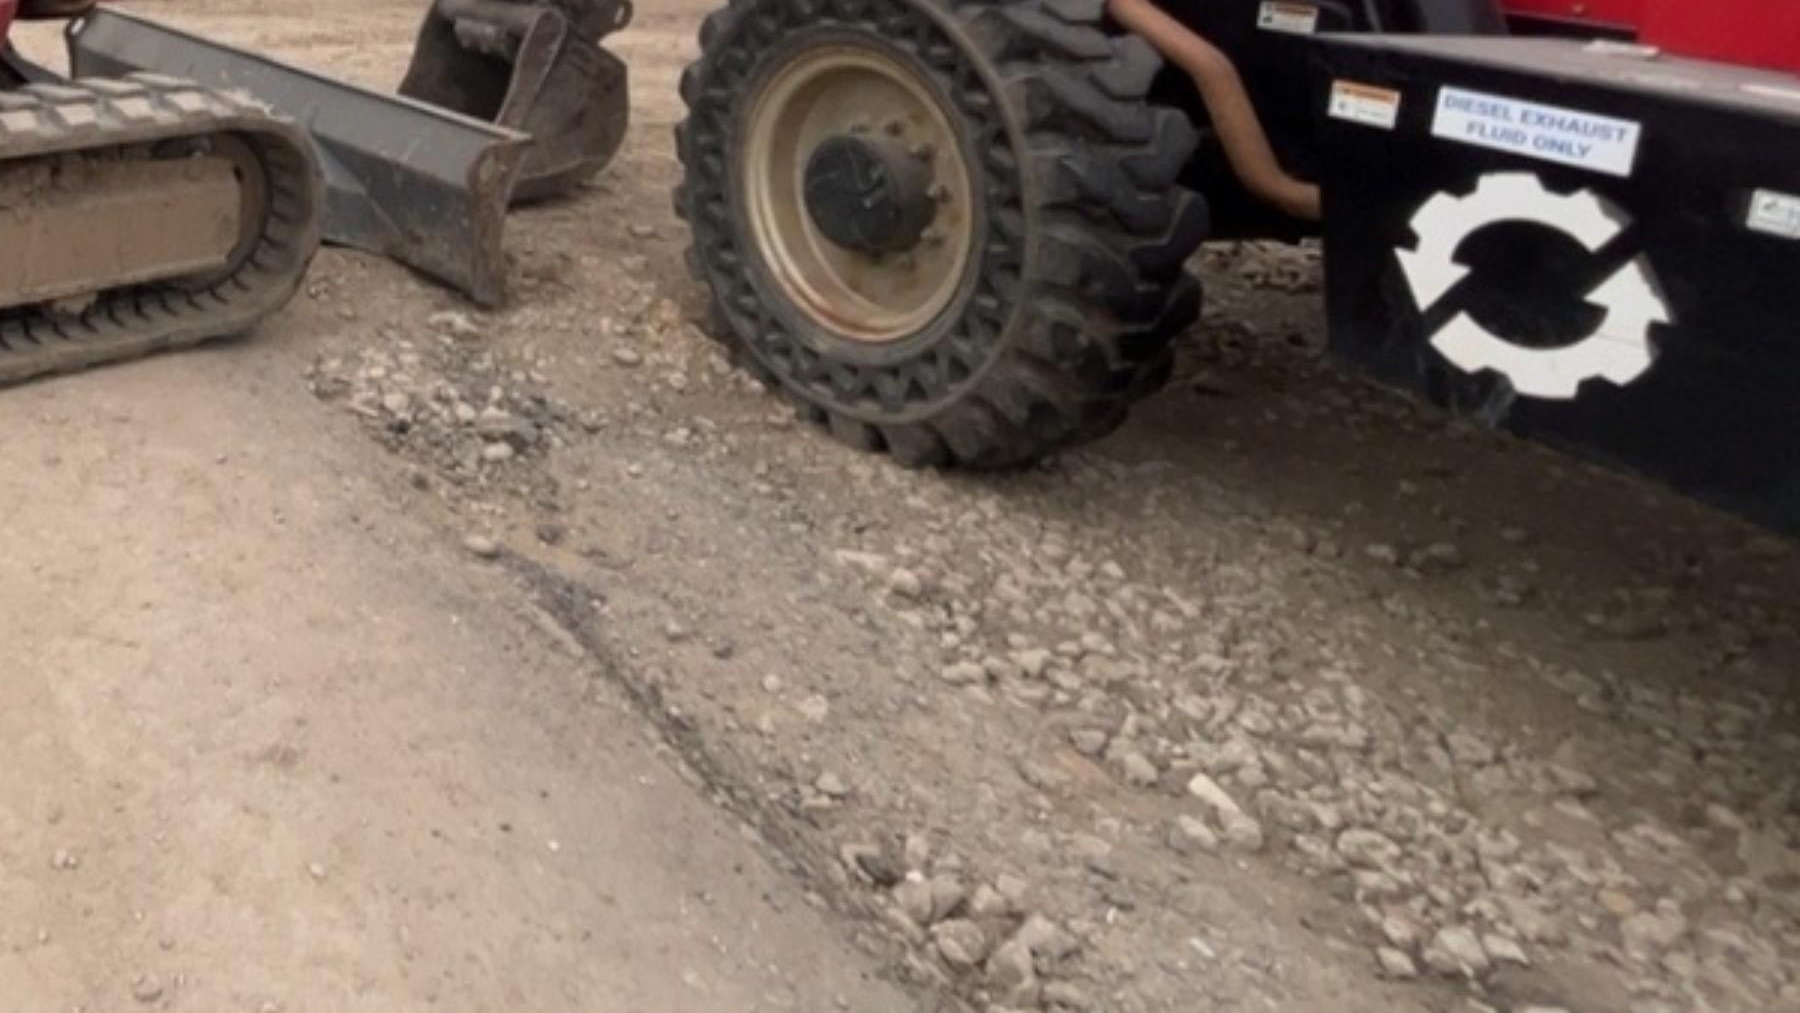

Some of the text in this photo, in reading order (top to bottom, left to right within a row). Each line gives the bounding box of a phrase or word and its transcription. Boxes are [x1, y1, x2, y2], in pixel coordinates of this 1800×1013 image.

[1444, 94, 1629, 143] DIESEL EXHAUST
[1465, 120, 1593, 159] FLUID ONLY
